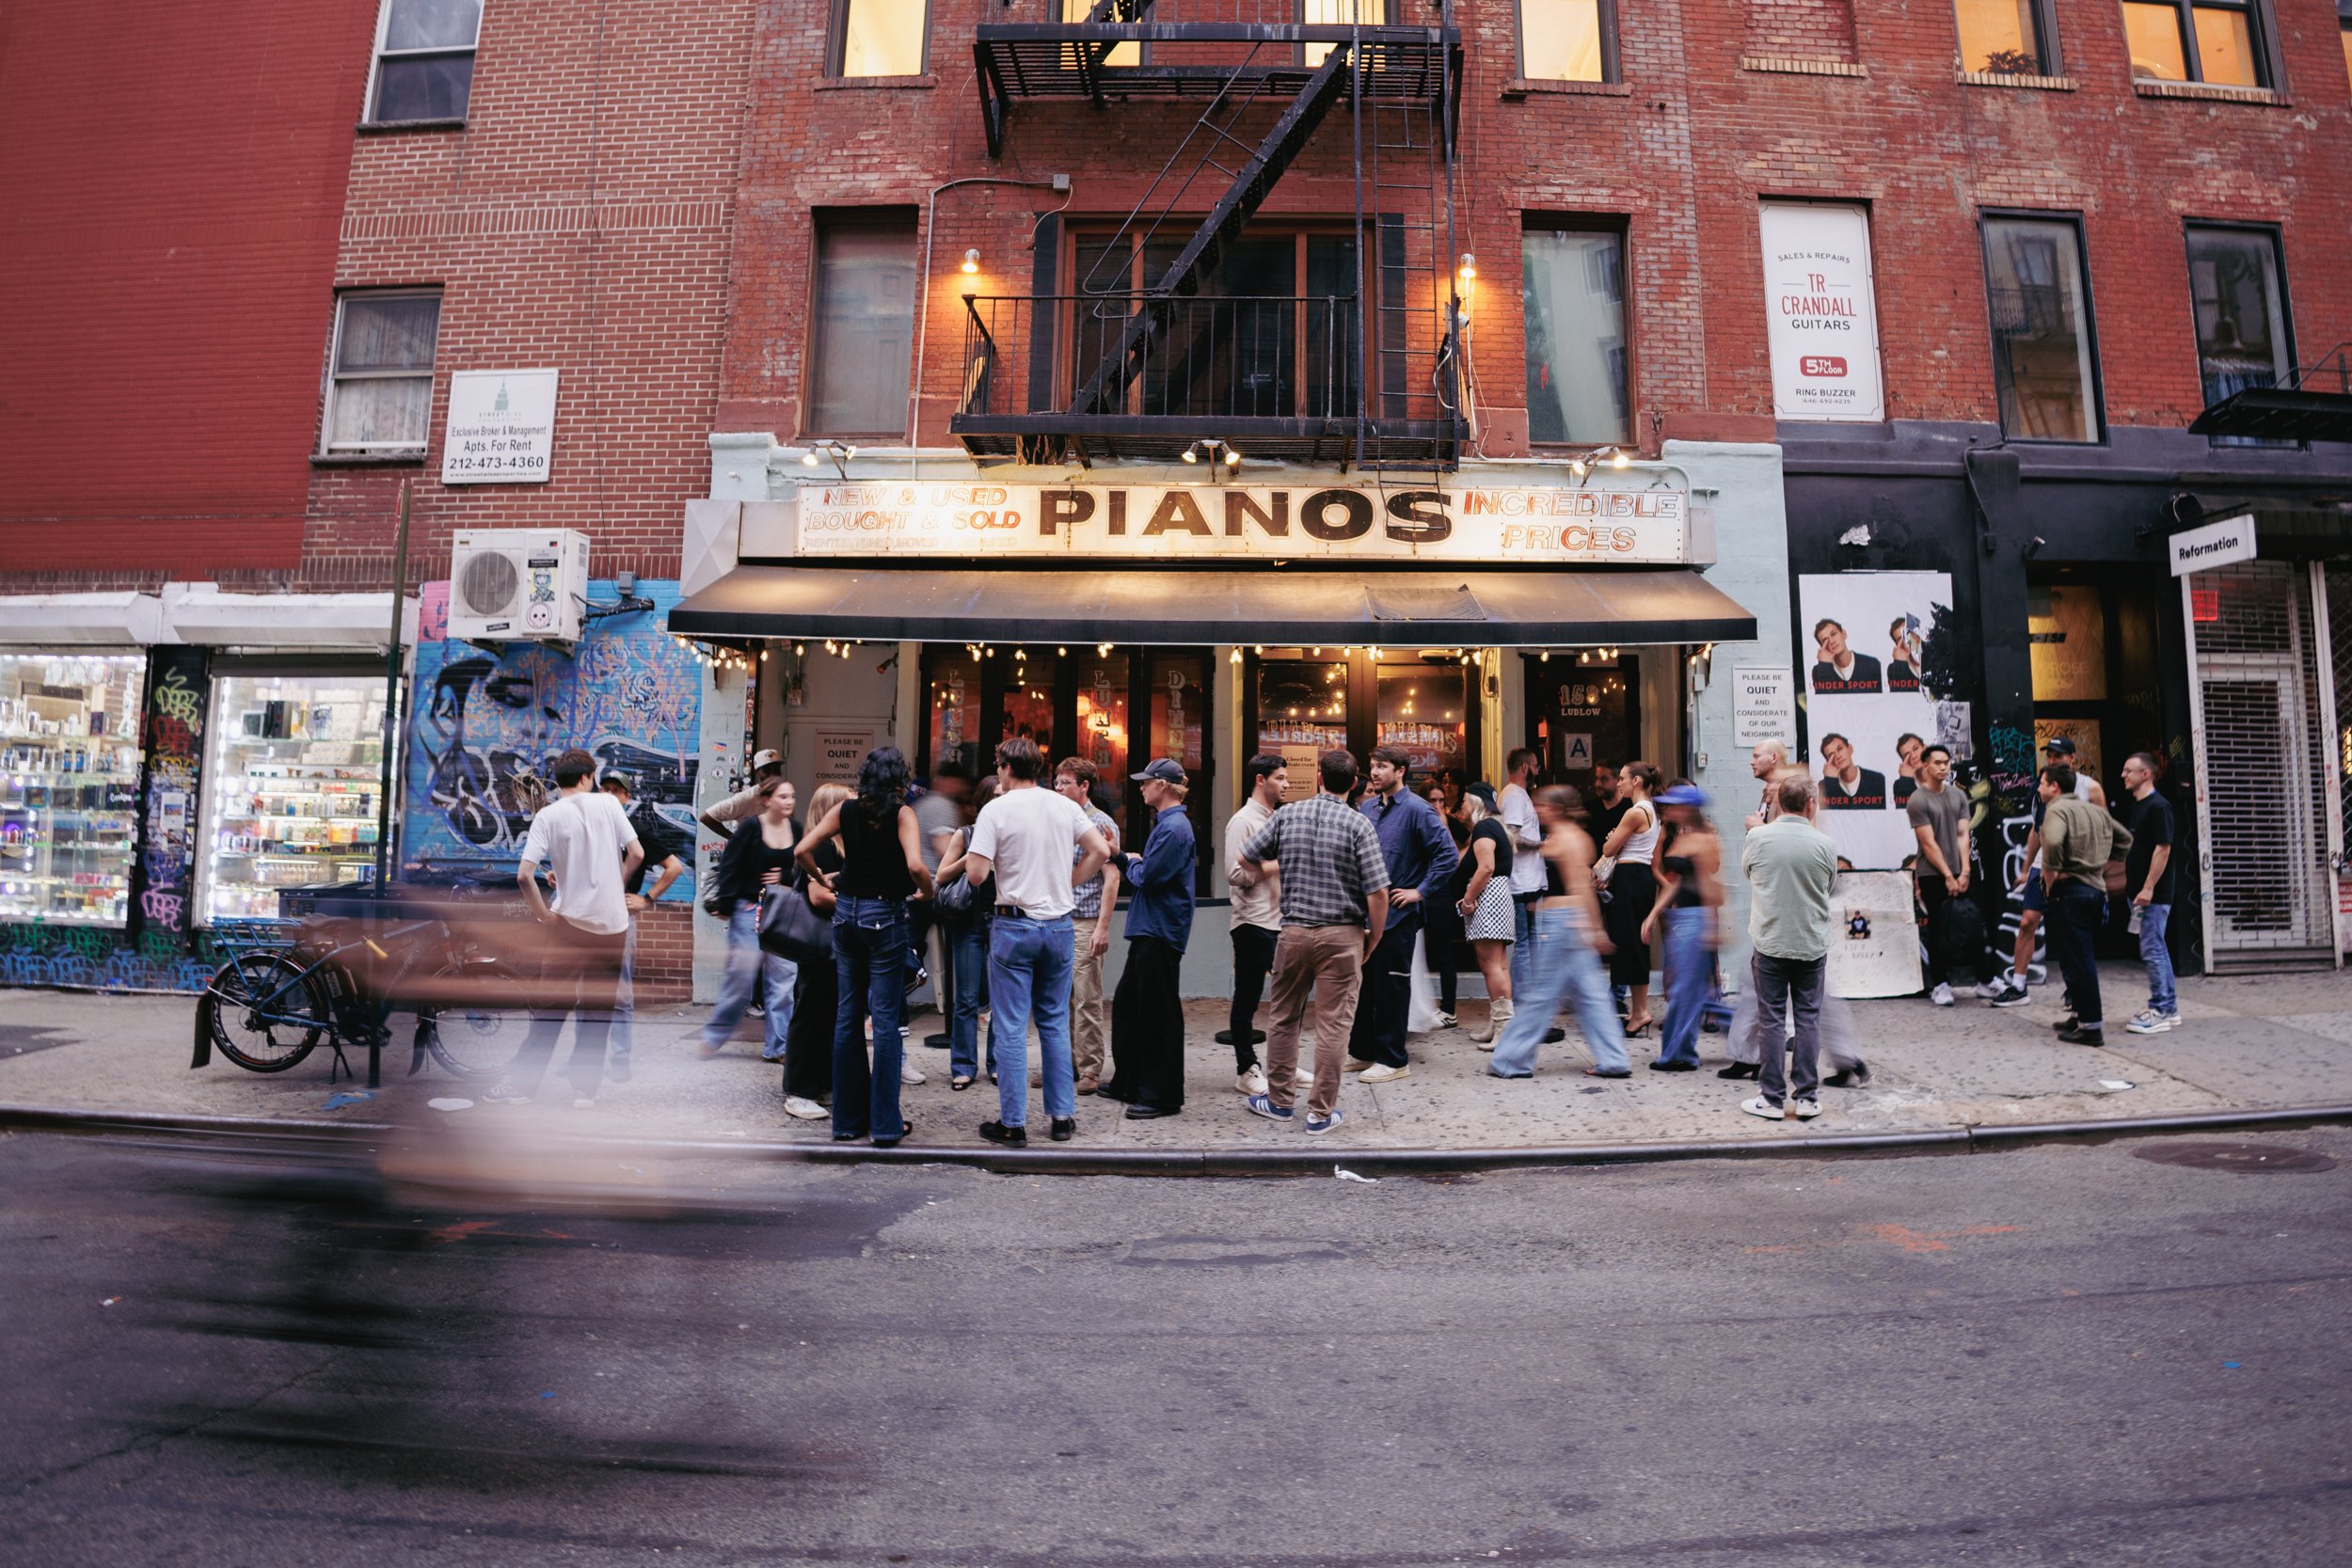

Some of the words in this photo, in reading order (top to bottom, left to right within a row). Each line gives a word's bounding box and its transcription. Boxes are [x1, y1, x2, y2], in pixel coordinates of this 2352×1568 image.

[1778, 252, 1804, 261] SALES
[1815, 252, 1851, 264] REPAIRS
[1807, 273, 1826, 293] TR
[1781, 295, 1857, 317] CRANDALL
[1791, 319, 1851, 330] GUITARS
[1820, 388, 1856, 397] BUZZER
[452, 426, 480, 436] Exclusive
[481, 425, 501, 436] Broker
[502, 425, 507, 435] &
[508, 425, 547, 437] Management
[464, 440, 488, 454] Apts.
[491, 439, 506, 451] For
[510, 438, 532, 451] Rent
[450, 456, 544, 469] 212-473-4360
[823, 487, 885, 506] NEW
[897, 487, 916, 506] &
[931, 487, 1008, 506] USED
[1463, 491, 1678, 518] INCREDIBLE
[808, 511, 910, 530] BOUGHT
[921, 512, 940, 529] &
[952, 511, 1022, 530] SOLD
[1039, 487, 1454, 544] PIANOS
[1503, 525, 1636, 552] PRICES
[2179, 536, 2238, 560] Reformation
[1747, 686, 1777, 694] QUIET
[1847, 680, 1879, 689] SPORT
[1093, 670, 1111, 768] LUNCH
[1168, 671, 1186, 764] DINNE
[828, 750, 858, 758] QUIET
[1569, 737, 1588, 758] A
[1851, 796, 1883, 804] SPORT
